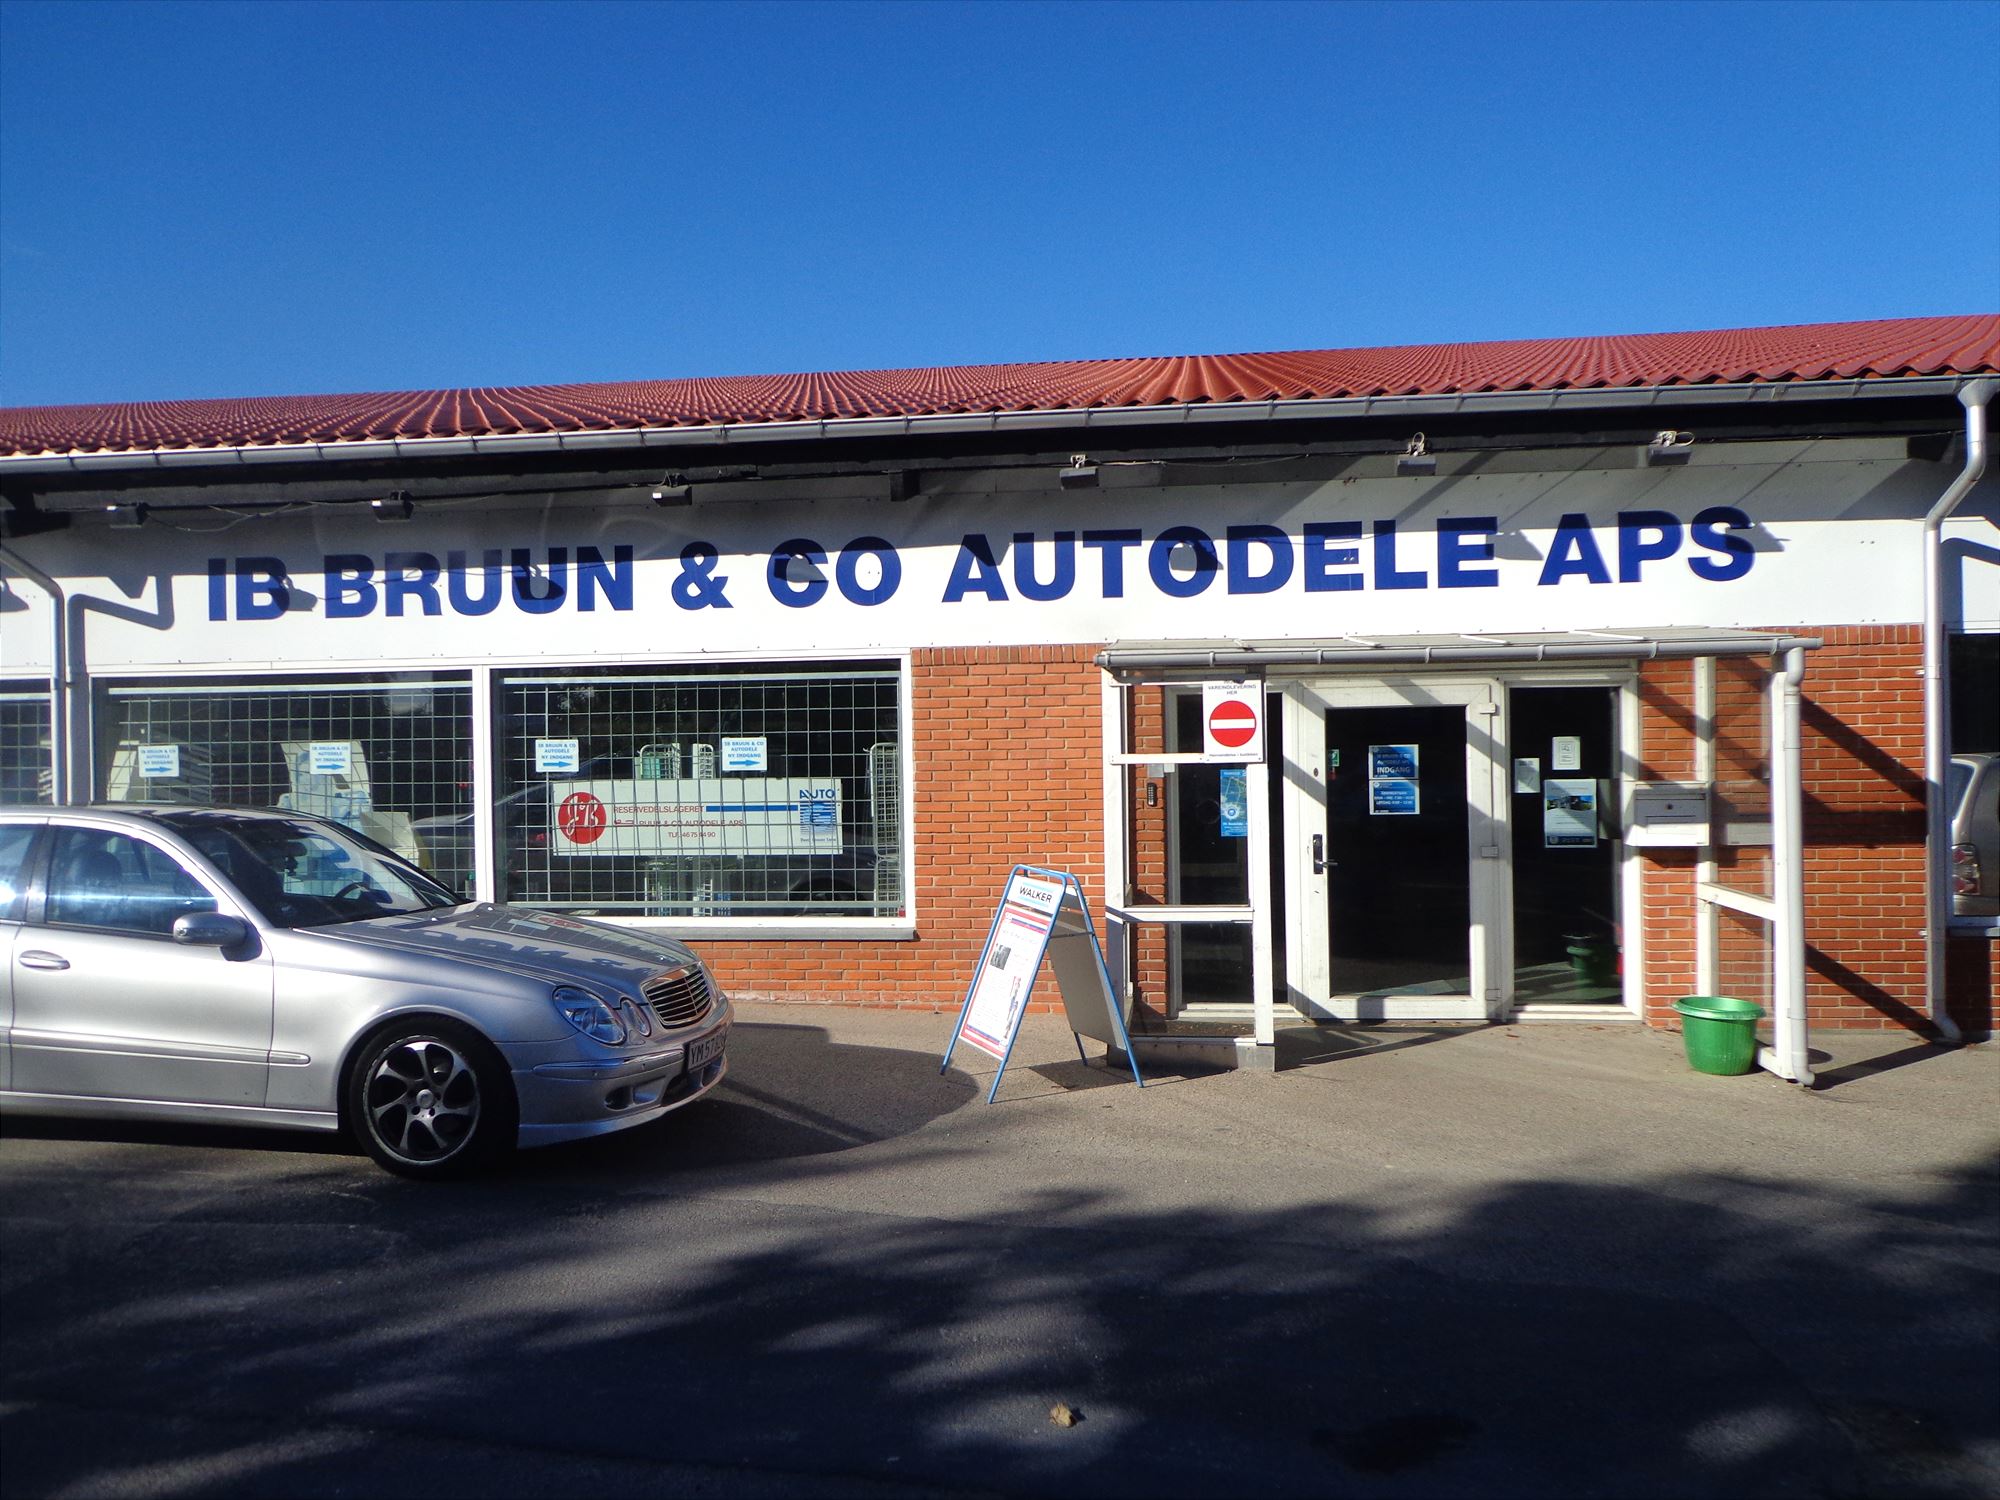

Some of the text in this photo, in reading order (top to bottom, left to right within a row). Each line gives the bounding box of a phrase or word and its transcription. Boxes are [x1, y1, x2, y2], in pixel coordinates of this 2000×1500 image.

[208, 506, 1756, 621] IB BRUUN & CO AUTODELE APS
[799, 788, 836, 799] AUTO
[613, 805, 704, 814] RESERVEDELSLAGERET
[1019, 885, 1053, 904] WALKER
